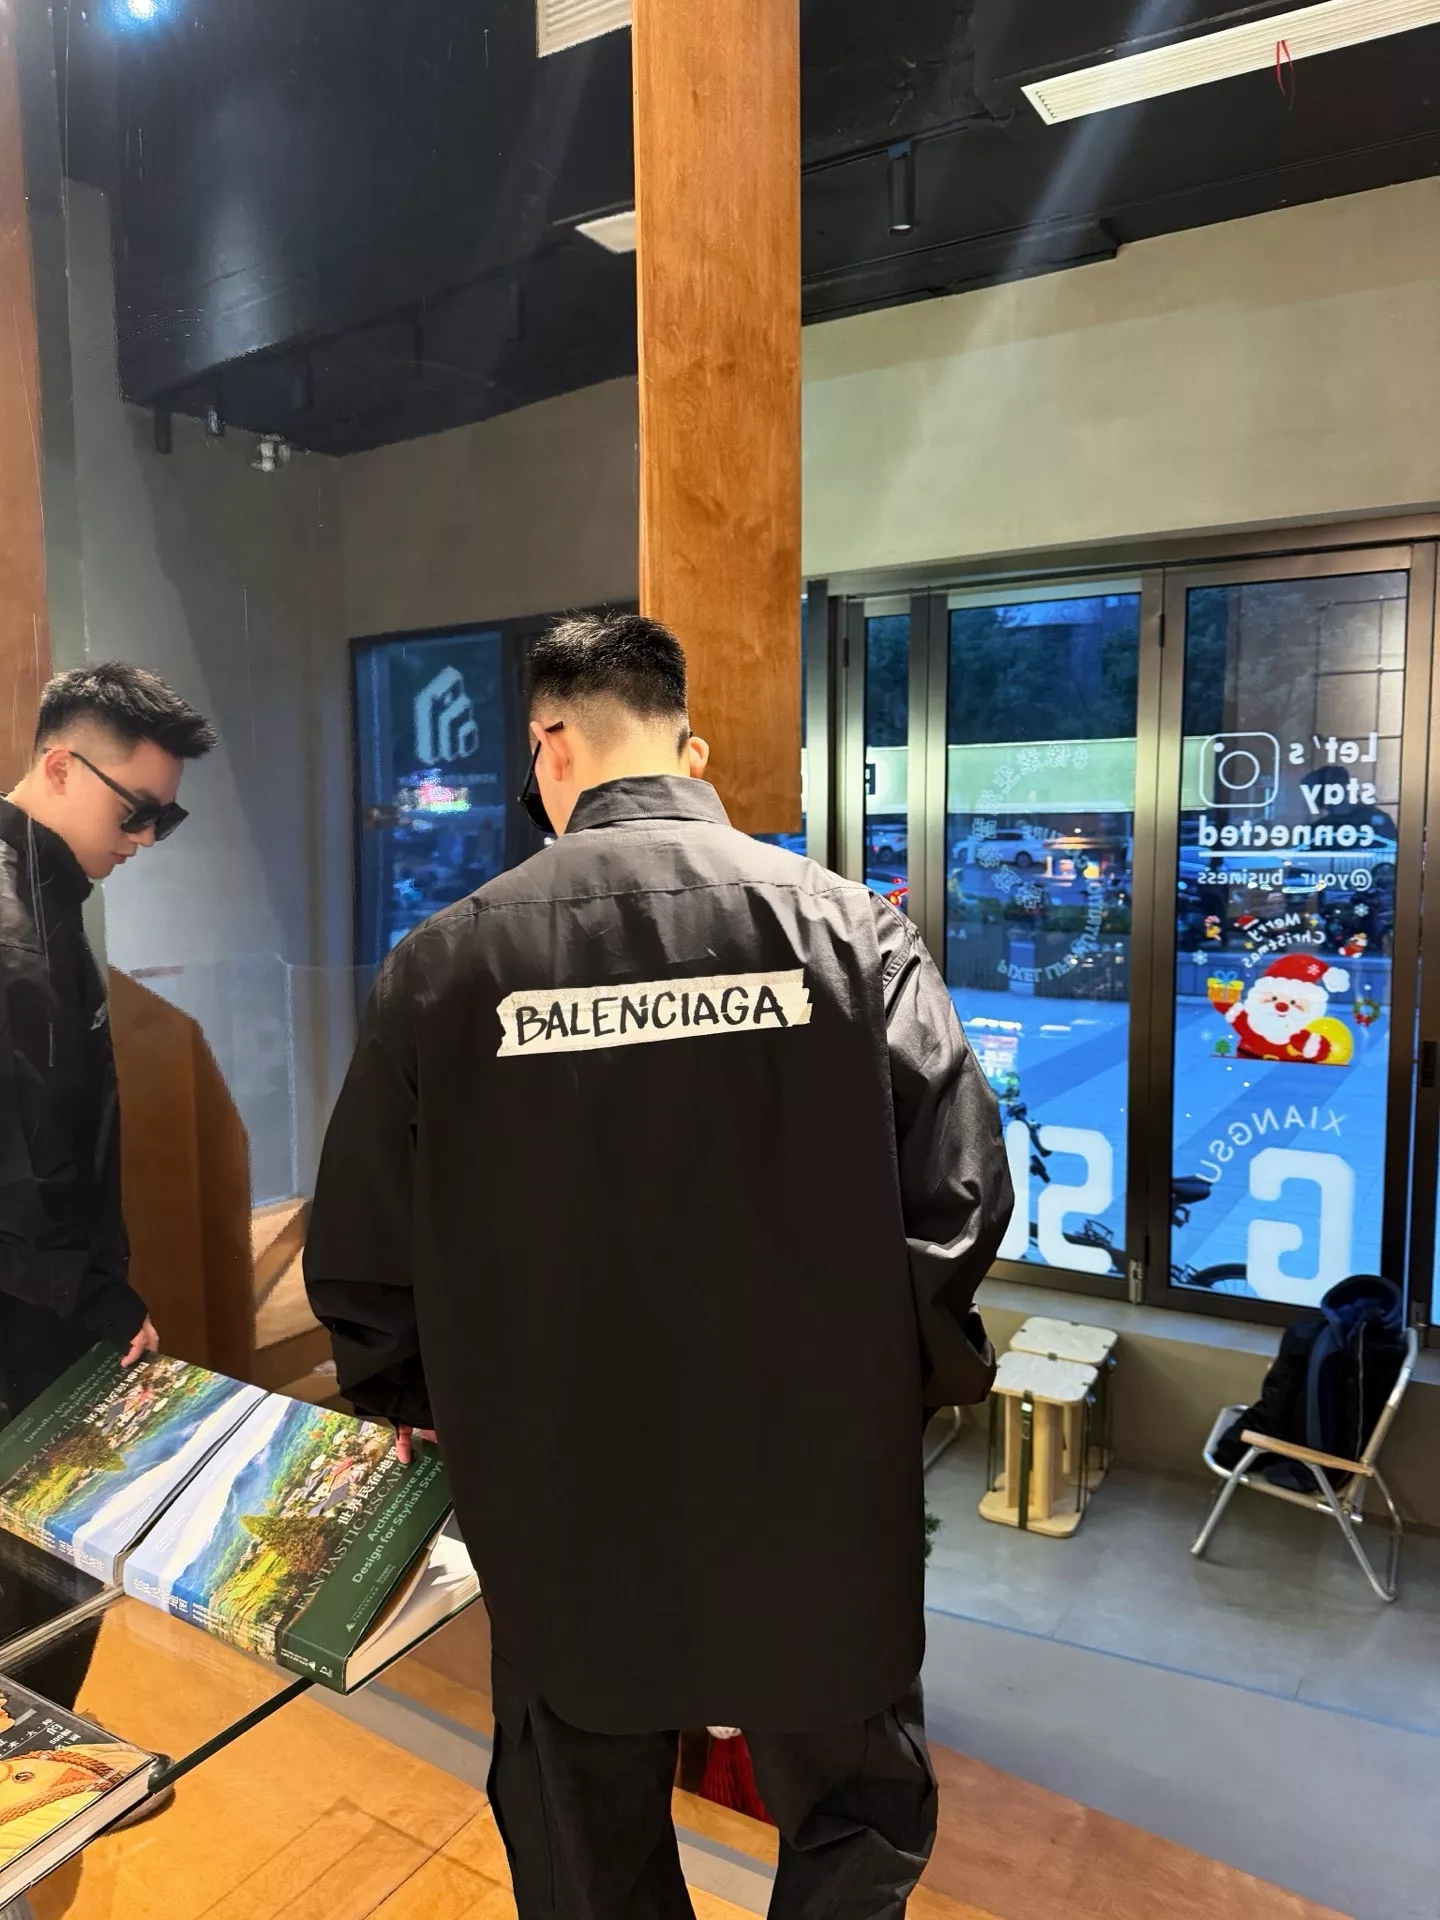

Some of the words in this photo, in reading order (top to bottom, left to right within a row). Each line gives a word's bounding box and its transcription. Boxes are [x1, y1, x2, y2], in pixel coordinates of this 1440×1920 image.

[515, 985, 789, 1046] BALENCIAGA
[338, 1446, 397, 1526] 世界民宿地图
[352, 1543, 385, 1584] Design
[380, 1526, 397, 1543] for
[393, 1488, 423, 1526] Stylish
[419, 1460, 444, 1489] Stays
[367, 1478, 418, 1542] Architecture
[414, 1455, 433, 1477] and
[294, 1518, 368, 1610] FANTASTIC
[368, 1452, 416, 1517] ESCAP
